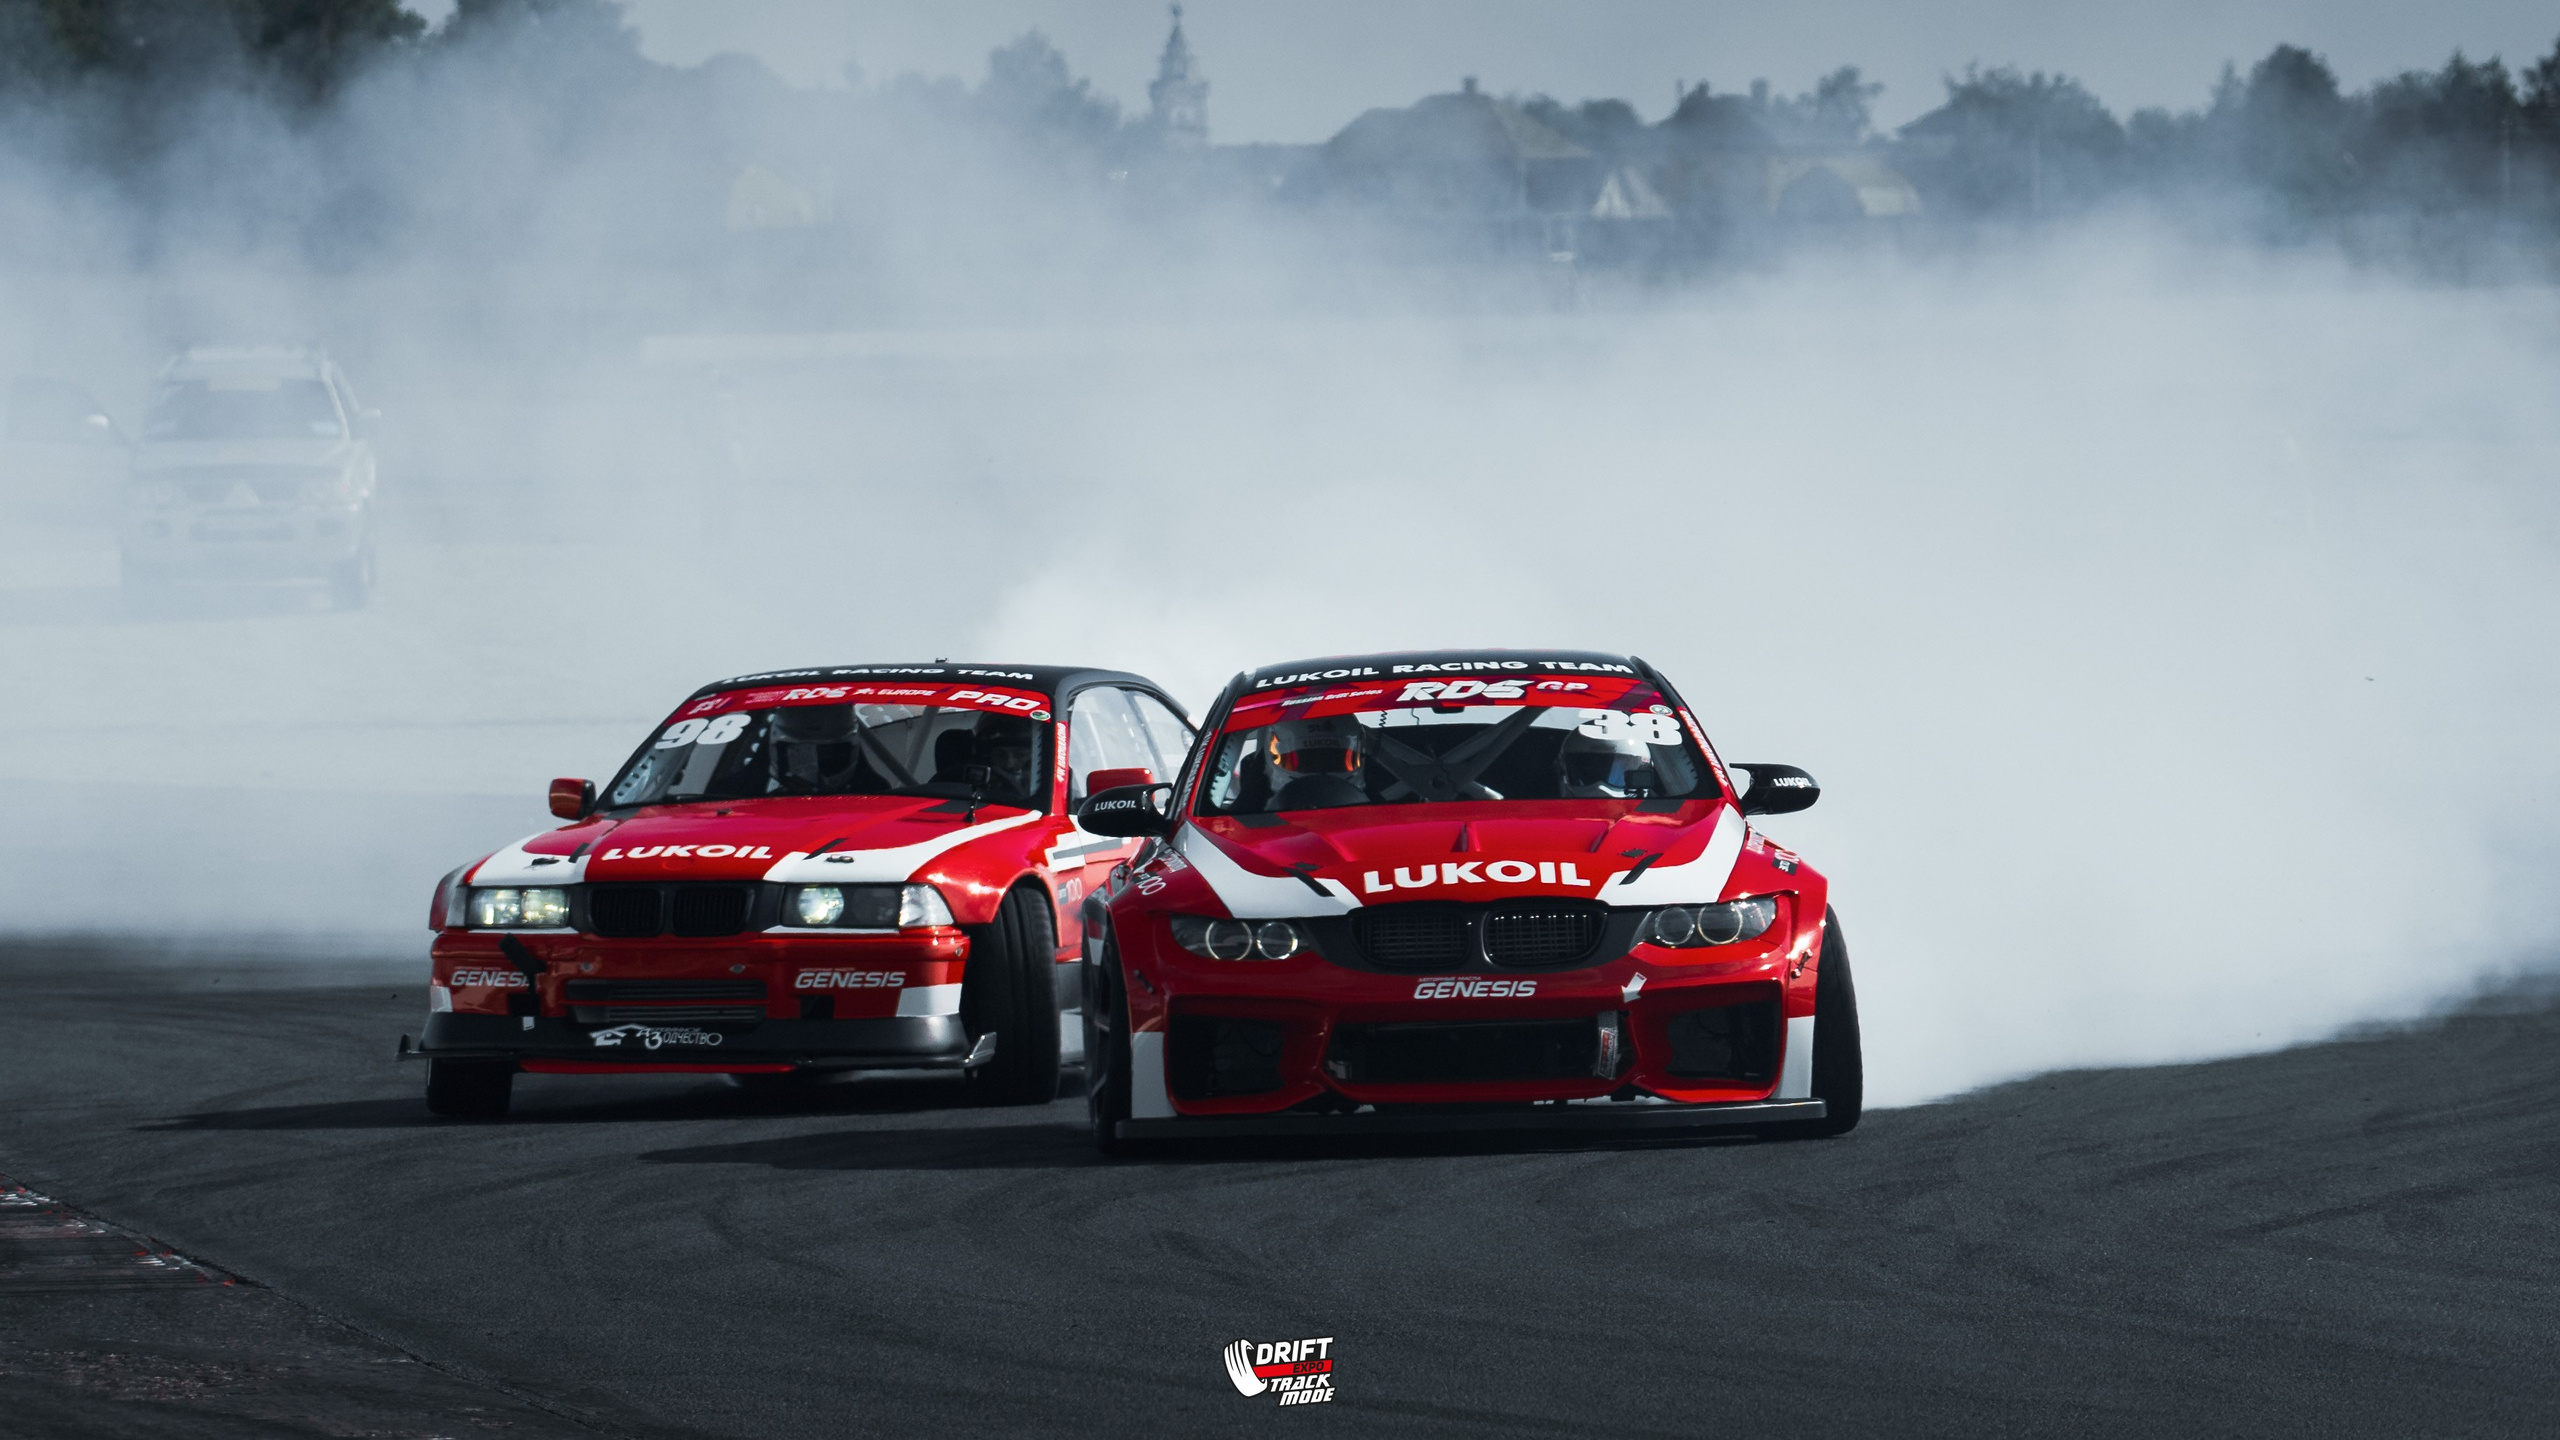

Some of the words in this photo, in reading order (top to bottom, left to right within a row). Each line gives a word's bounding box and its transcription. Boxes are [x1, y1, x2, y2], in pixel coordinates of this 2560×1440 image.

[831, 667, 945, 675] RACING
[957, 669, 1034, 681] TEAM
[1256, 667, 1379, 689] LUKOIL
[1392, 661, 1528, 674] RACING
[1538, 661, 1634, 674] TEAM
[877, 688, 937, 697] EUROPE
[1396, 679, 1536, 701] RDS
[1536, 680, 1590, 692] GP
[947, 690, 1042, 710] PRO
[654, 713, 752, 750] 98
[1578, 708, 1683, 746] 38
[1773, 776, 1812, 788] LUKOIL
[1094, 800, 1137, 812] LUKOIL
[601, 844, 774, 861] LUKOIL
[1363, 860, 1591, 894] LUKOIL
[795, 971, 907, 988] GENESIS
[1413, 981, 1538, 1000] GENESIS
